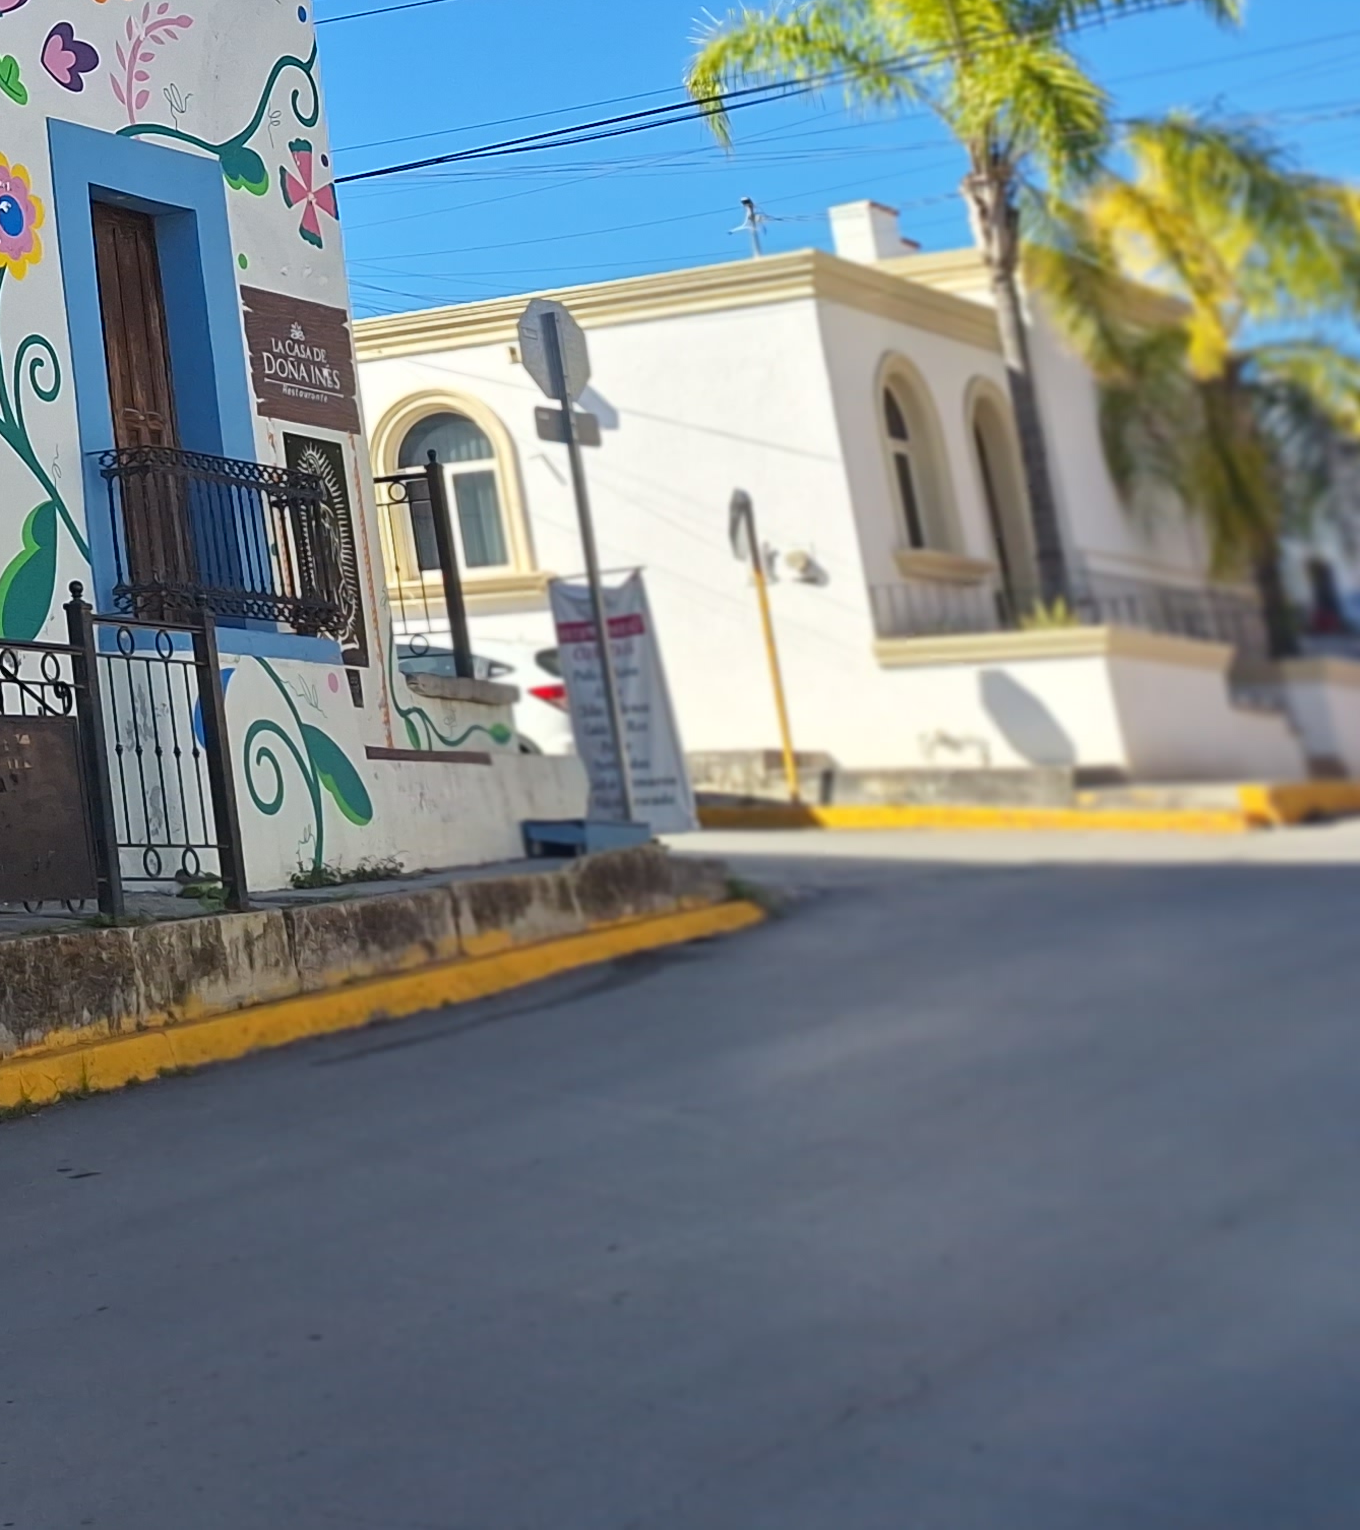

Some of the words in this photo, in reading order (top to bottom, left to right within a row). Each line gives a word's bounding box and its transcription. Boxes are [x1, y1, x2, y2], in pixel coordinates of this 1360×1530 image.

[271, 337, 285, 354] LA
[285, 340, 312, 361] CASA
[313, 347, 327, 363] DE
[262, 352, 309, 383] DOÑA
[310, 364, 340, 390] INÉS
